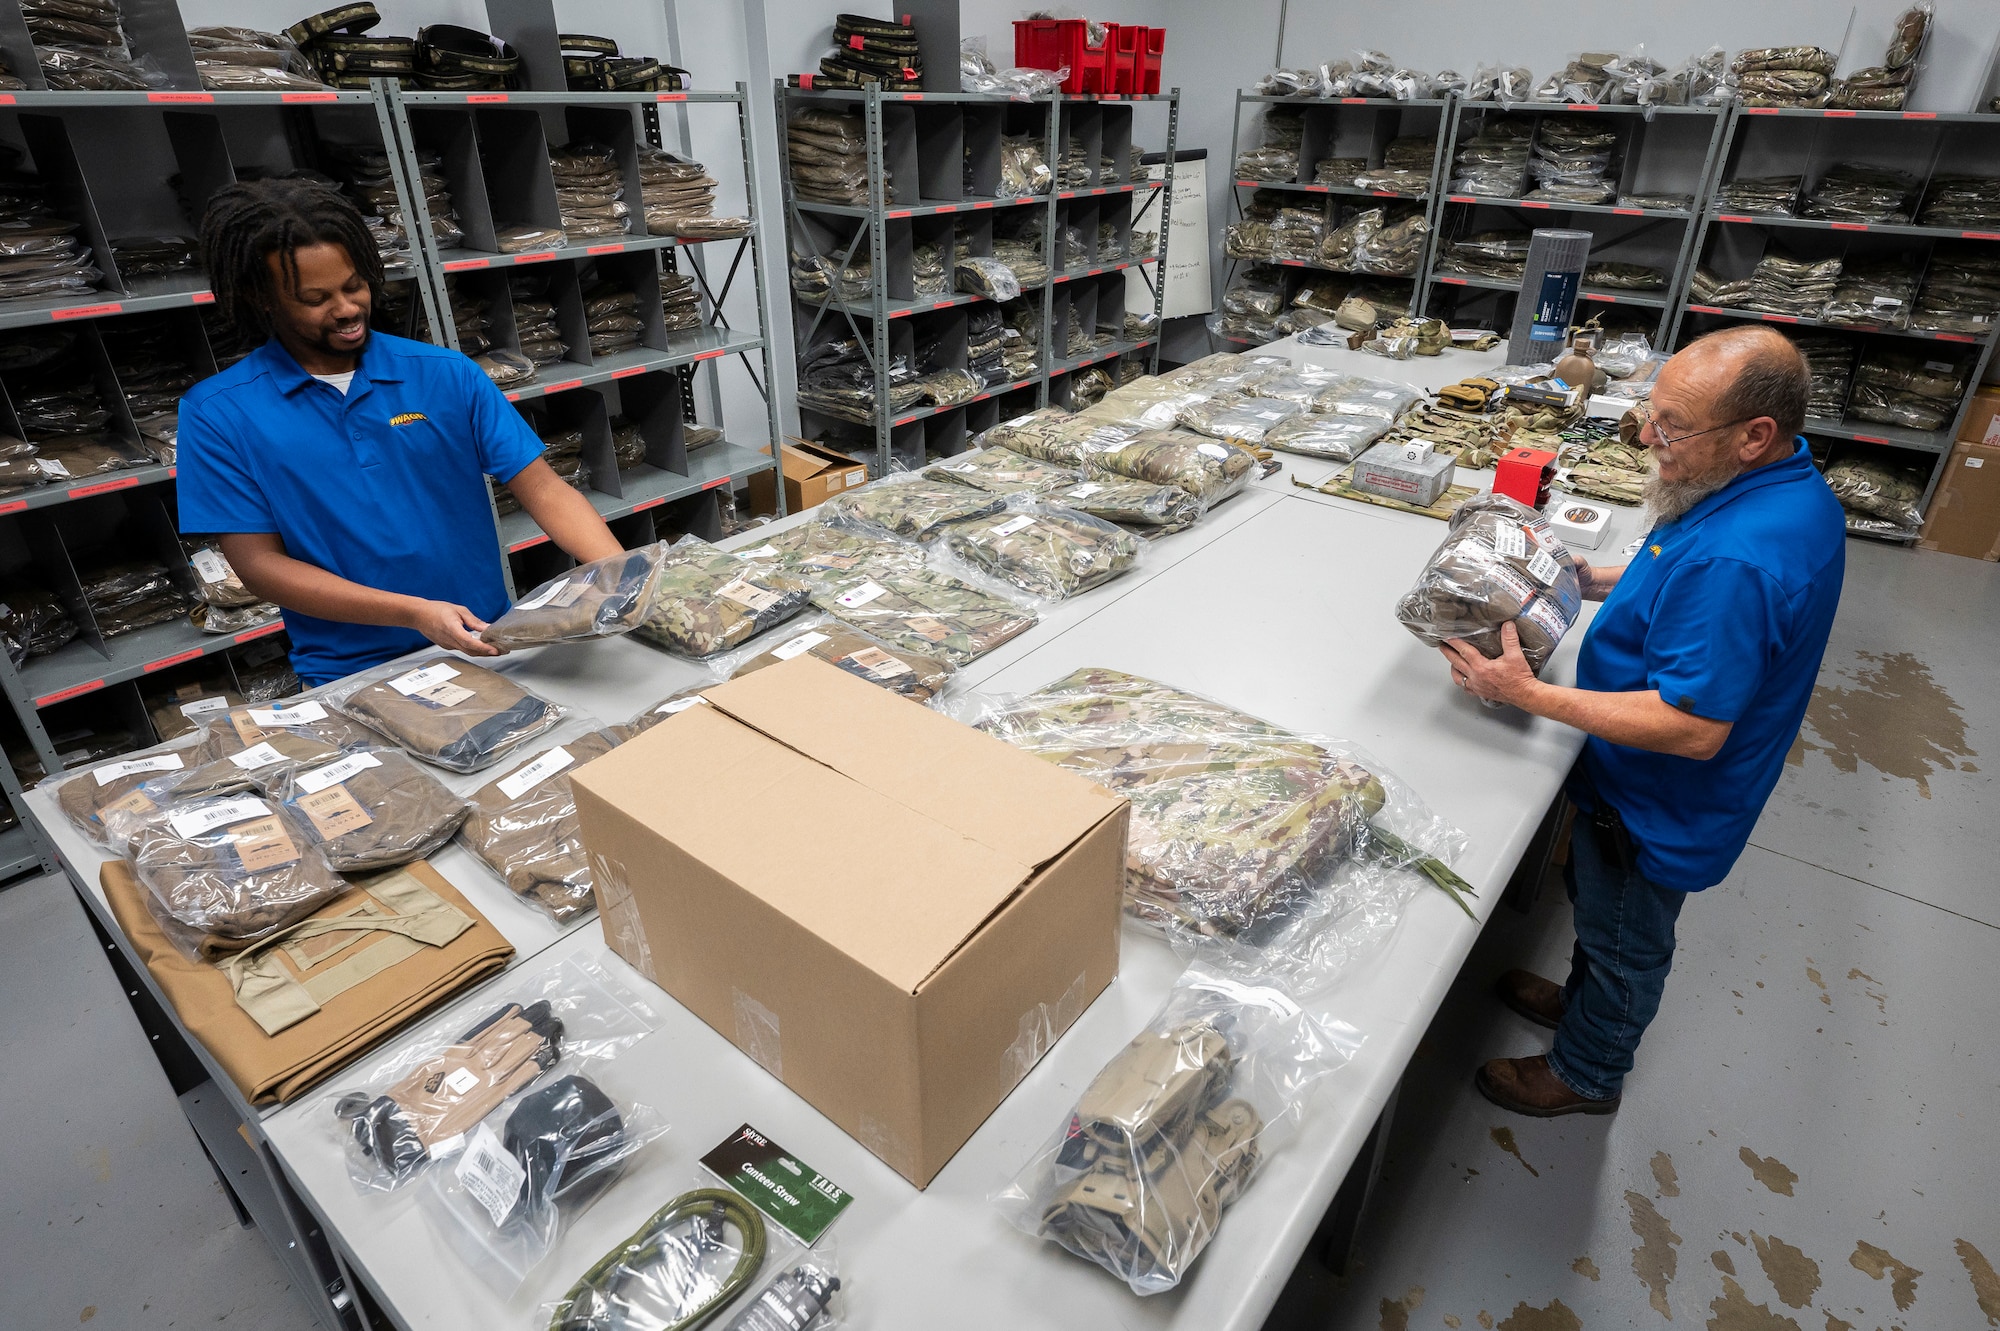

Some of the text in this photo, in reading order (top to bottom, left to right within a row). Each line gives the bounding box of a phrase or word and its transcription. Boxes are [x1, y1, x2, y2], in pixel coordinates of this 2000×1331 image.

[742, 1127, 768, 1147] SAYRE
[741, 1162, 776, 1190] Canteen
[773, 1185, 801, 1207] Straw
